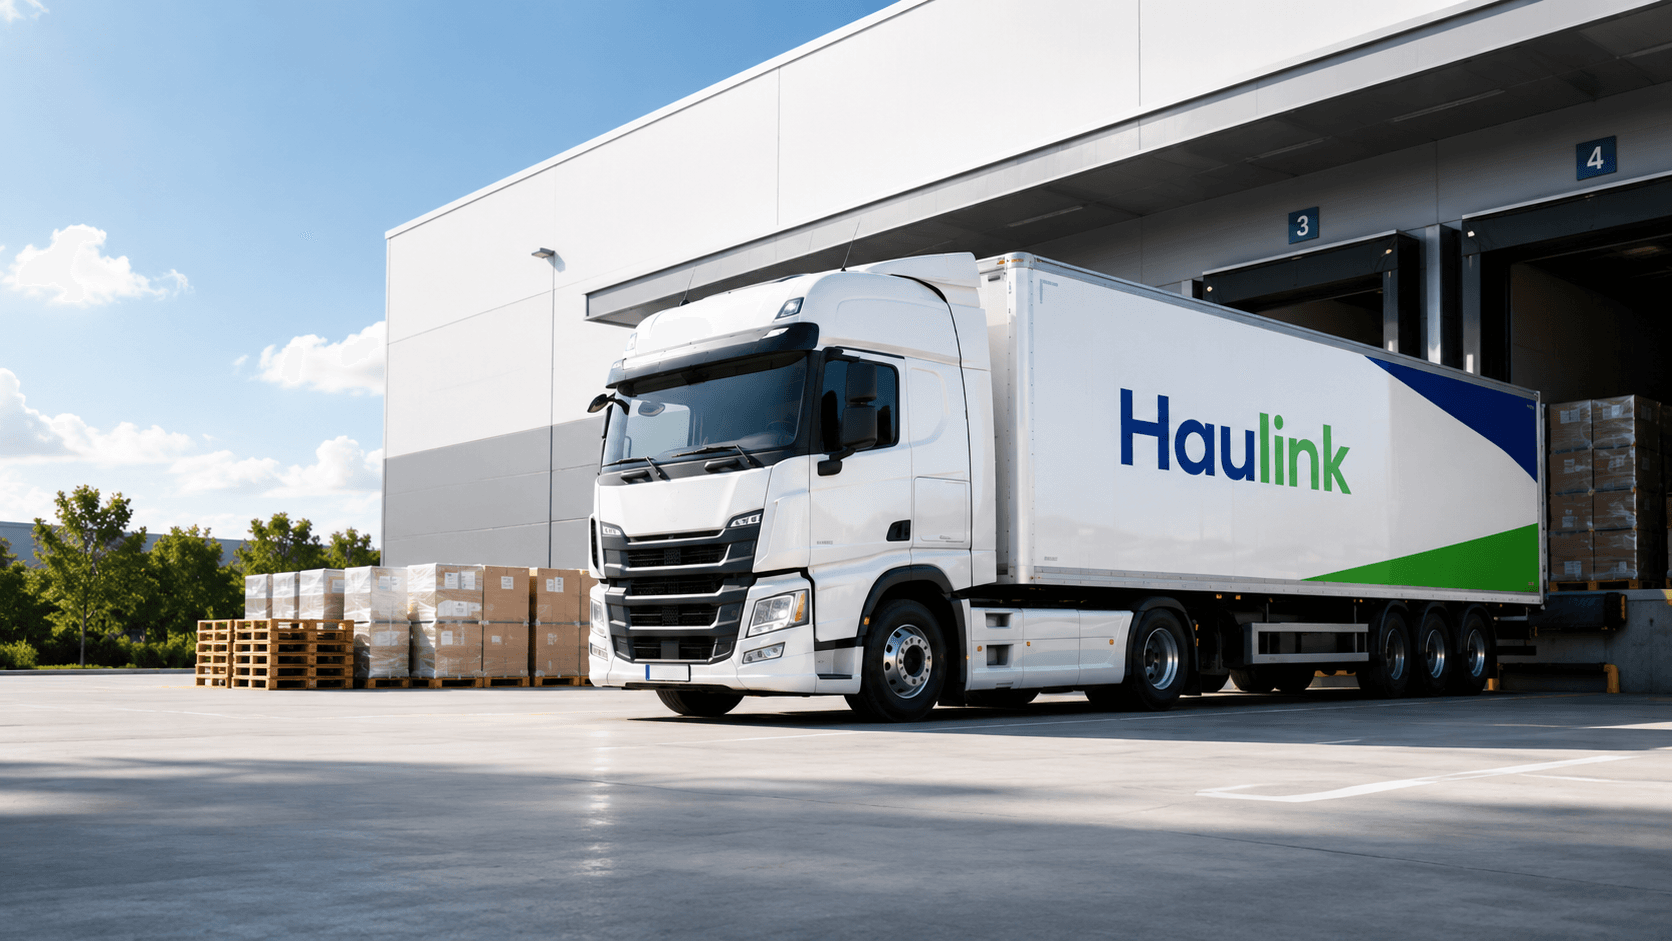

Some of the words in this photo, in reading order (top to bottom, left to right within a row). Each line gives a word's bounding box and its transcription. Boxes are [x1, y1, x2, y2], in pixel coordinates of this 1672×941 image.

[1587, 146, 1604, 169] 4
[1297, 215, 1309, 236] 3
[1120, 388, 1351, 495] Haulink
